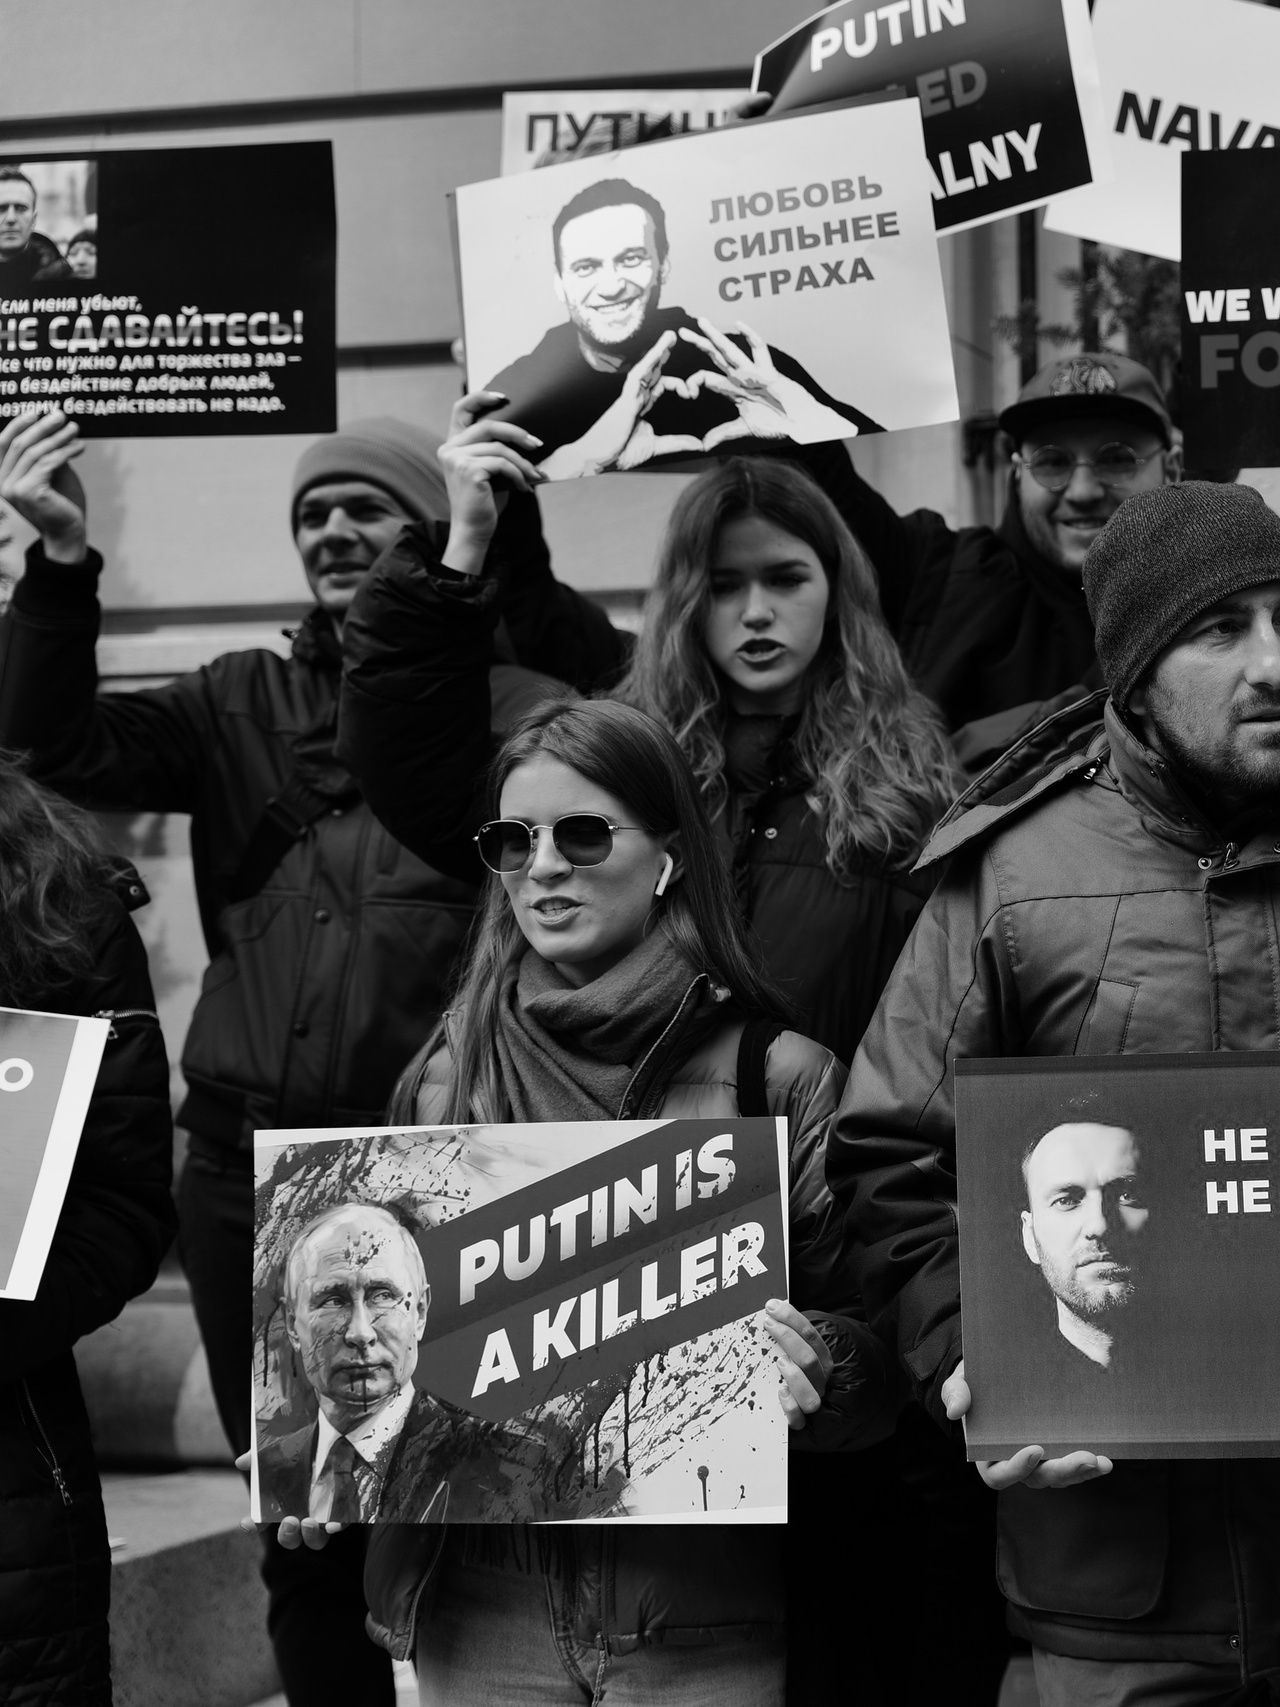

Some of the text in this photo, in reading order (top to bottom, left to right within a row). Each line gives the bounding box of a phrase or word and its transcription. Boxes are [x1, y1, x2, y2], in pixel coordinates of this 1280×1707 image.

[810, 0, 967, 72] PUTIN
[709, 176, 883, 224] ЛЮБОВЬ
[714, 211, 900, 263] СИЛЬНЕЕ
[719, 257, 875, 302] СТРАХА
[33, 297, 78, 313] меня
[1185, 288, 1250, 323] WE
[48, 305, 304, 353] СДАВАЙТЕСЬ!
[20, 374, 133, 395] бездействие
[135, 373, 207, 395] добрых
[210, 371, 275, 391] людей,
[23, 356, 54, 372] что
[56, 355, 117, 374] нужно
[119, 355, 155, 371] для
[157, 352, 252, 372] торжества
[210, 398, 234, 413] не
[236, 396, 286, 413] надо.
[1203, 1128, 1268, 1162] НЕ
[1205, 1180, 1271, 1214] НЕ
[460, 1134, 737, 1305] PUTIN IS
[471, 1221, 768, 1398] A KILLER
